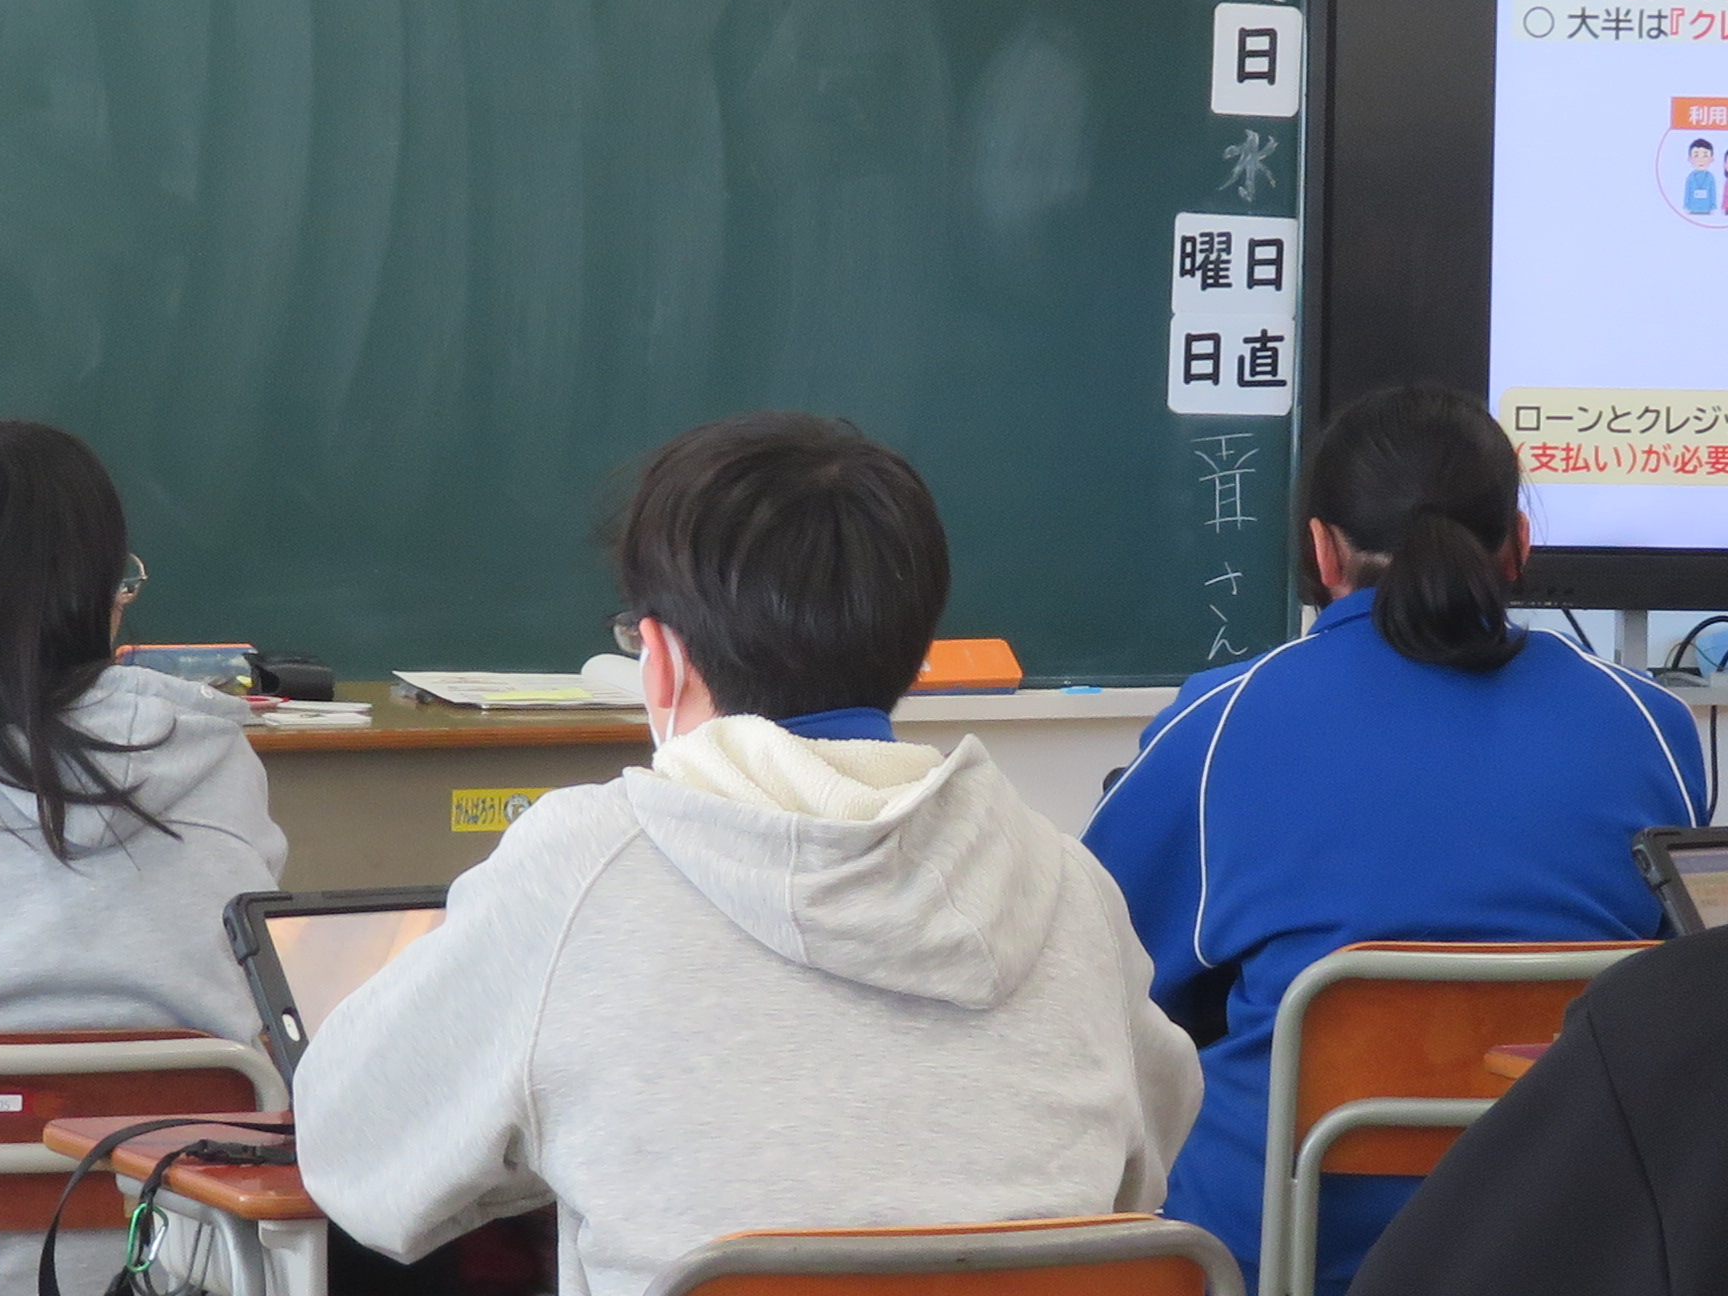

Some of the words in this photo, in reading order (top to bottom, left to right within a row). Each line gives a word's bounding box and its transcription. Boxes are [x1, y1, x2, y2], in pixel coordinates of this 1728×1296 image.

[1236, 26, 1278, 86] 日
[1218, 128, 1279, 203] 水
[1179, 231, 1285, 292] 曜日
[1183, 328, 1288, 389] 日直
